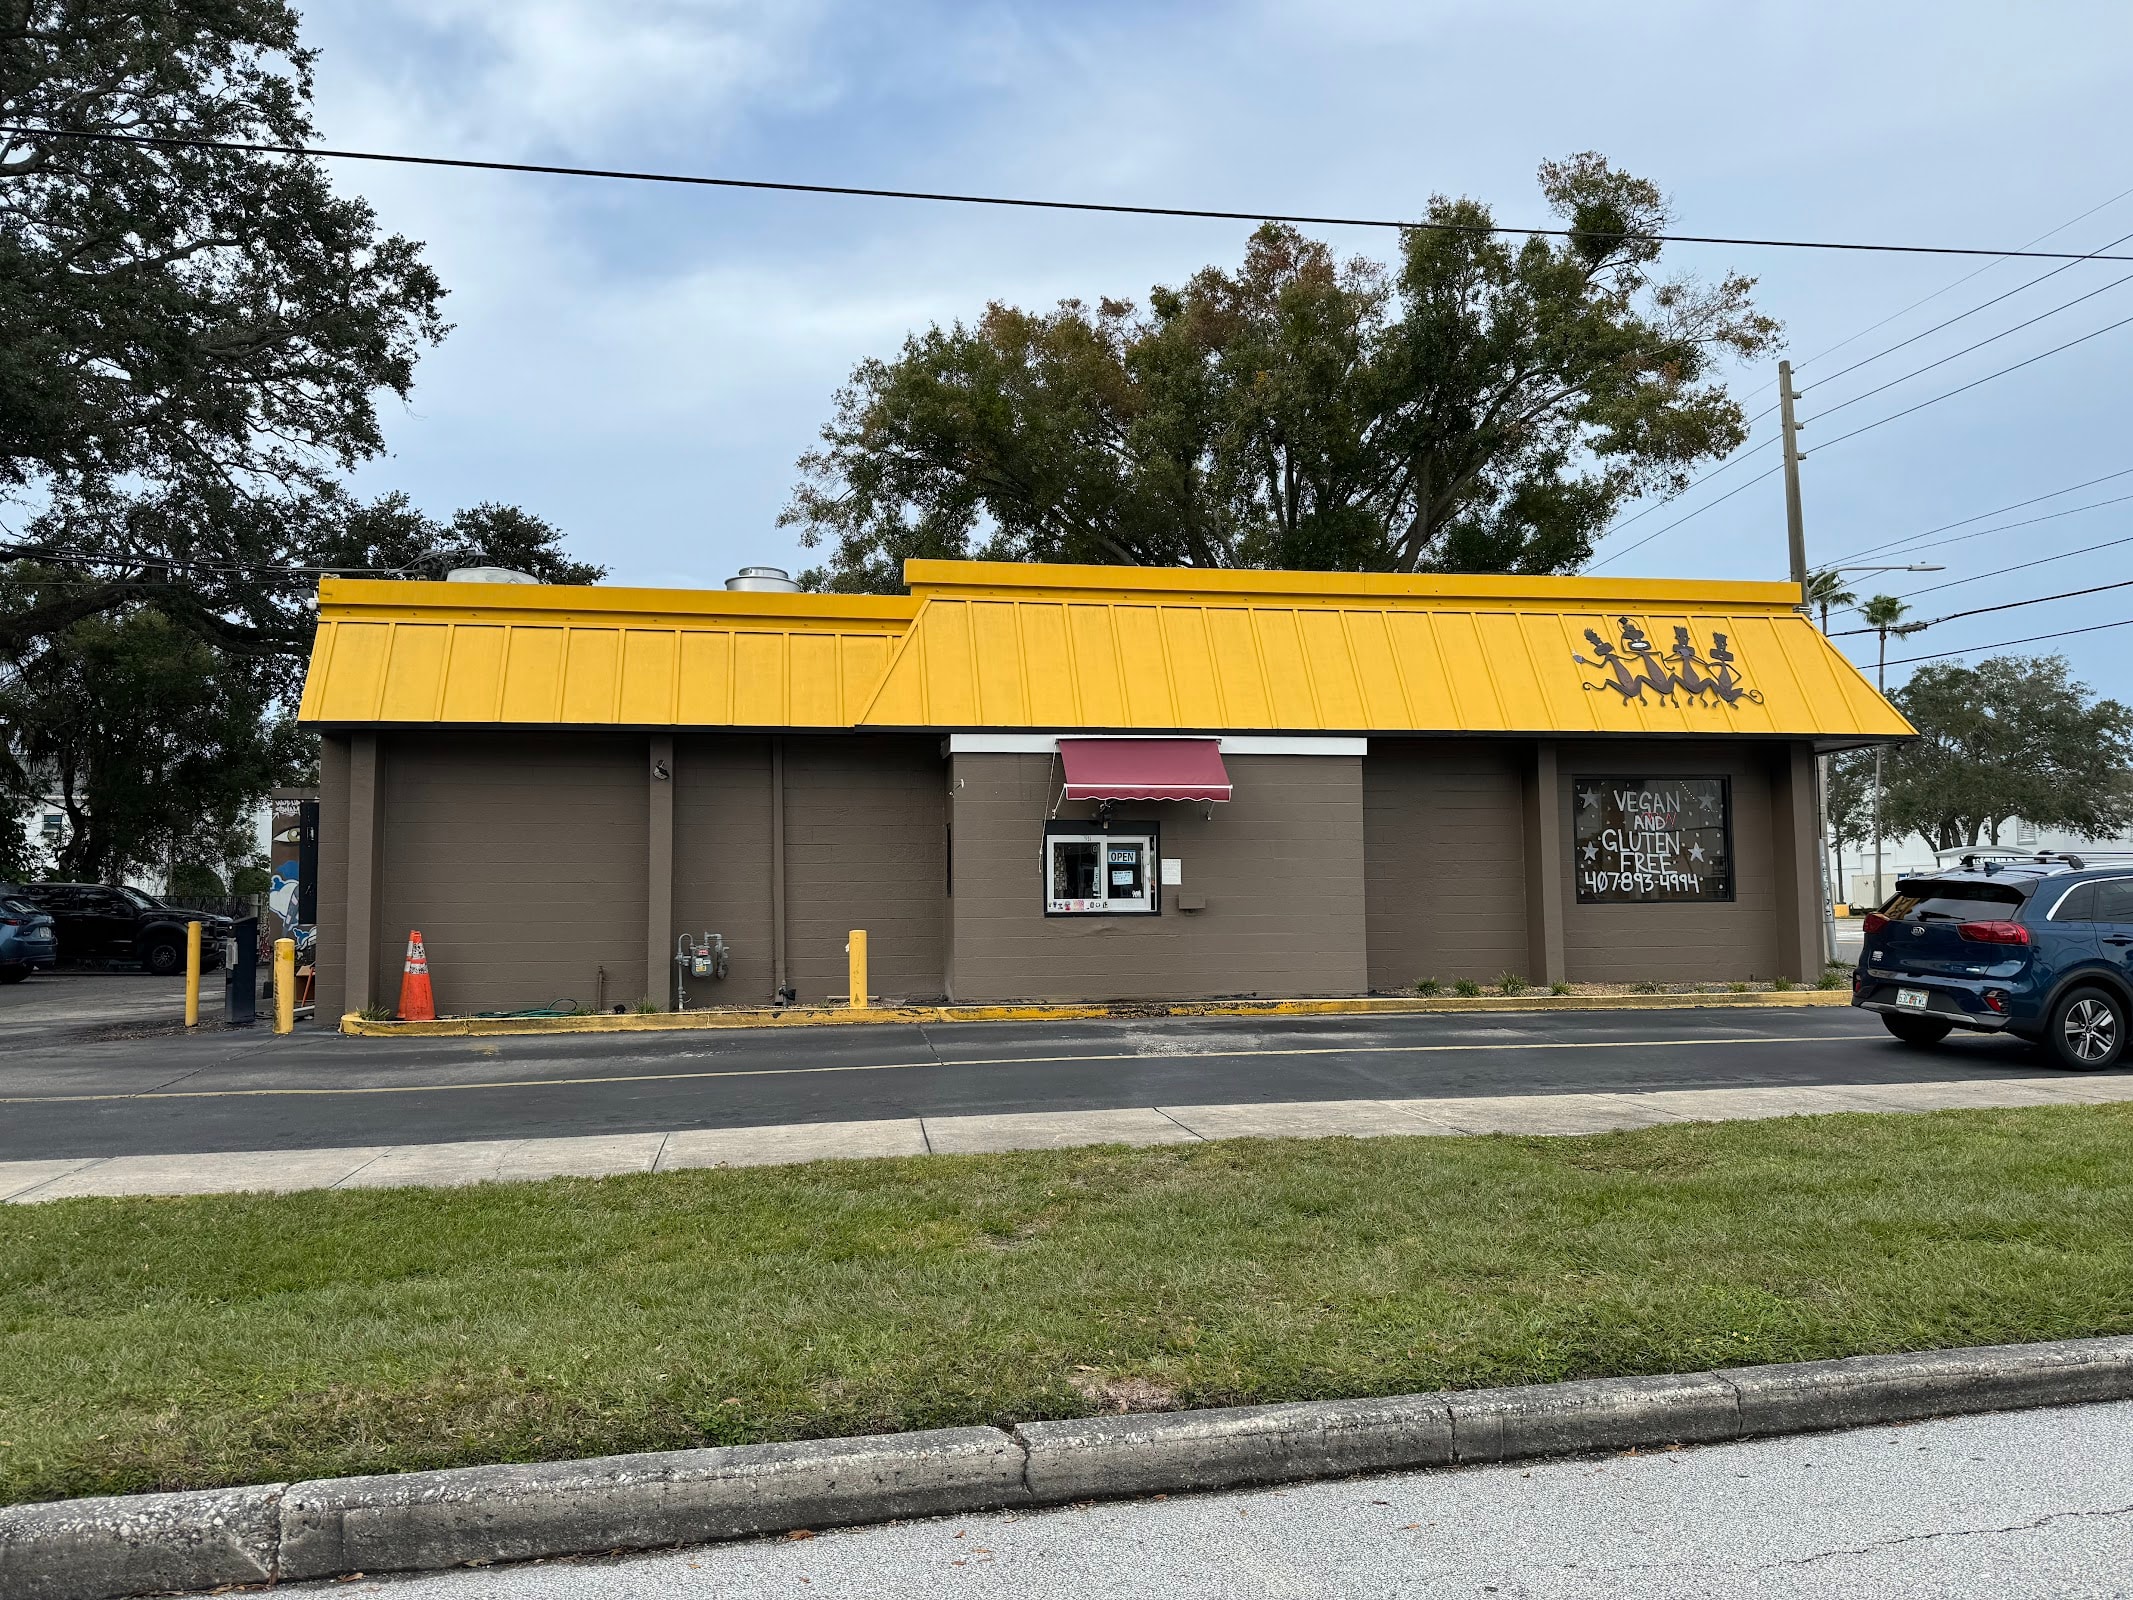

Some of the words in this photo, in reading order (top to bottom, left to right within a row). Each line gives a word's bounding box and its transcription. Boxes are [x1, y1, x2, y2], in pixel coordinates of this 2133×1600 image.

[1613, 790, 1680, 813] VEGAN
[1634, 815, 1666, 831] AND
[1602, 829, 1680, 855] GLUTEN
[1110, 852, 1134, 862] OPEN
[1620, 852, 1677, 875] FREE
